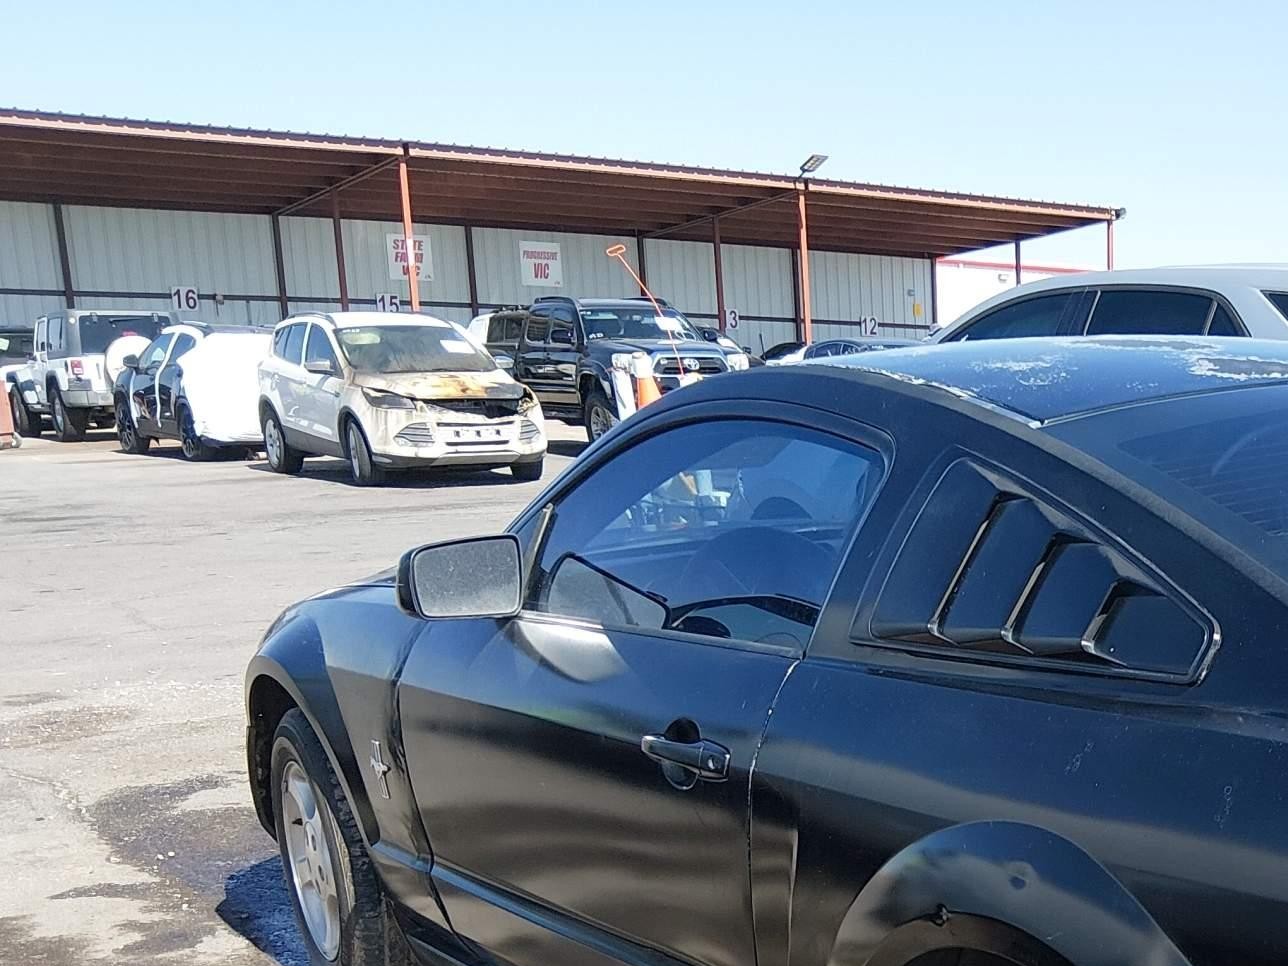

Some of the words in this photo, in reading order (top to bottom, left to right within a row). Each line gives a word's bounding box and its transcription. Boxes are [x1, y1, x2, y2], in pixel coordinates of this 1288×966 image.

[392, 238, 424, 251] STTE
[394, 251, 424, 264] FAM
[402, 264, 421, 277] VC
[533, 262, 550, 280] VIC
[173, 288, 197, 310] 16
[378, 294, 399, 313] 15
[729, 310, 738, 329] 3
[862, 317, 877, 335] 12
